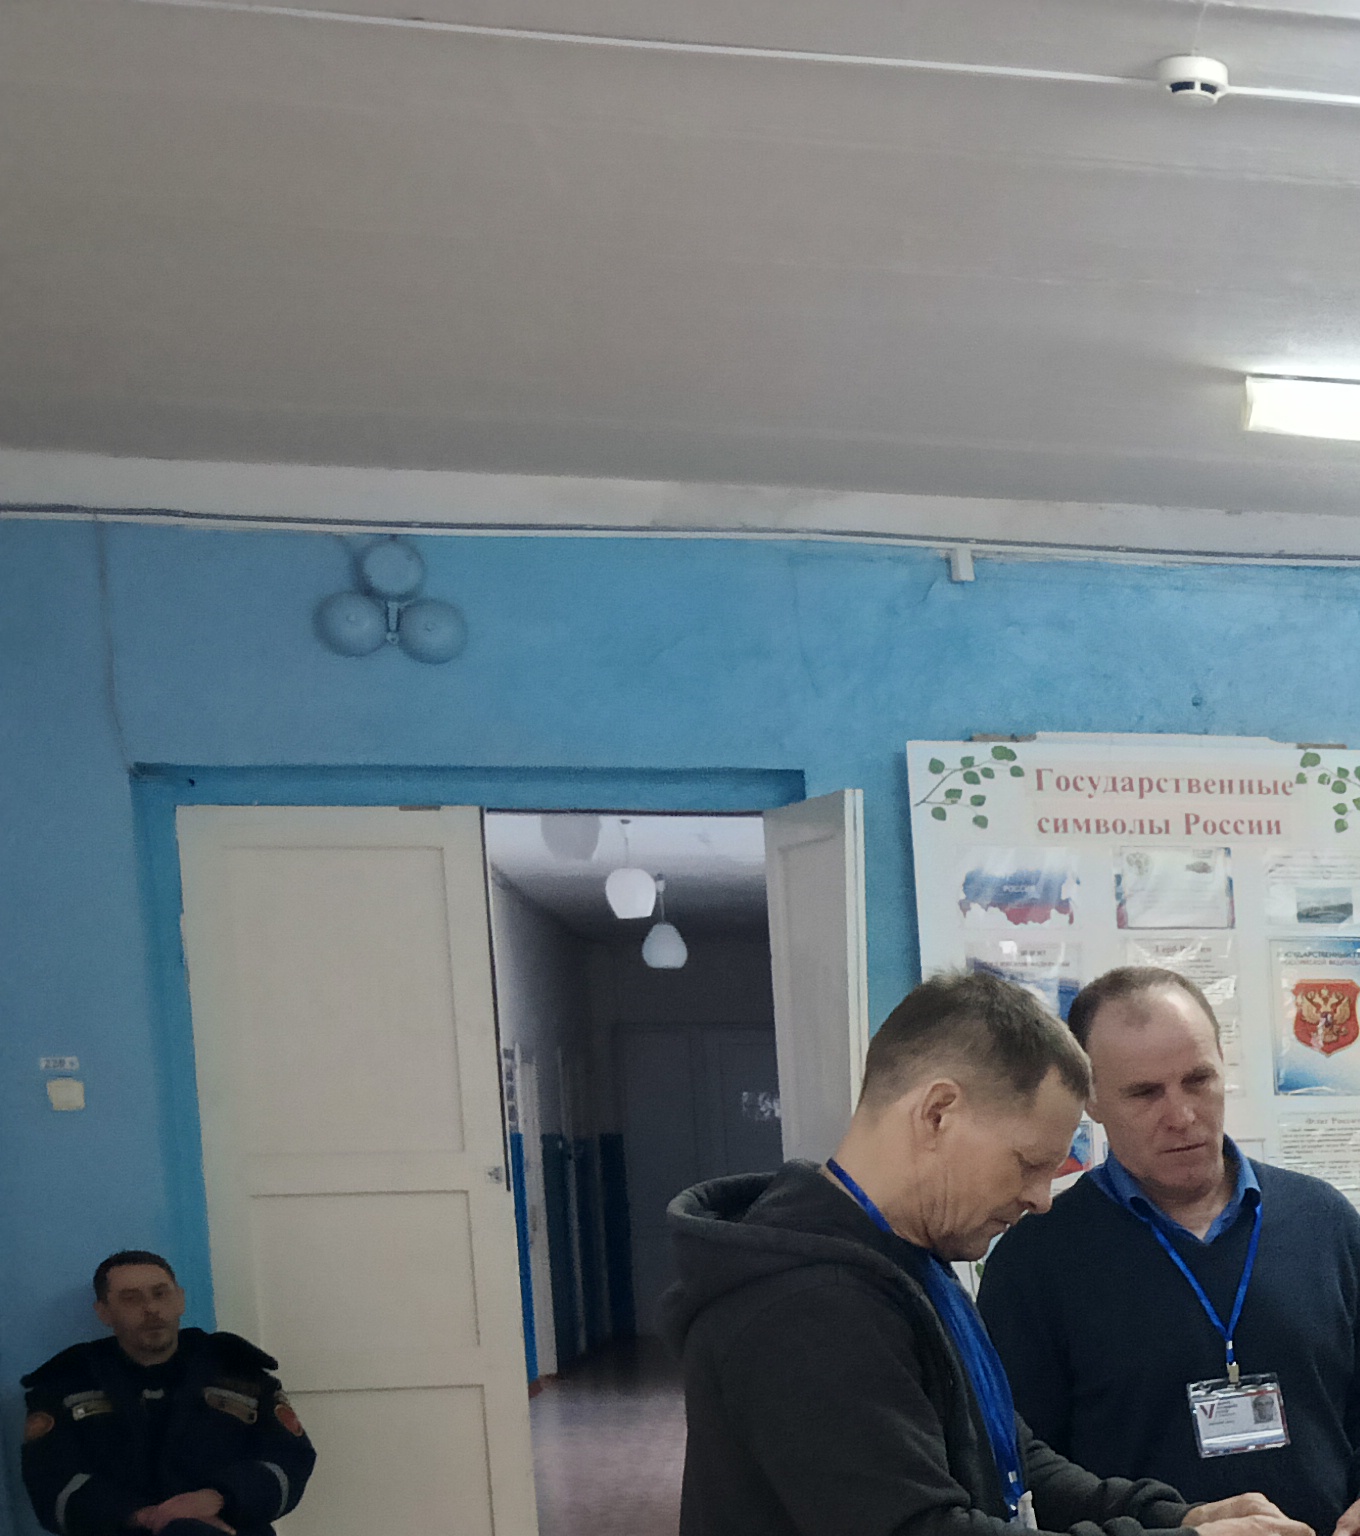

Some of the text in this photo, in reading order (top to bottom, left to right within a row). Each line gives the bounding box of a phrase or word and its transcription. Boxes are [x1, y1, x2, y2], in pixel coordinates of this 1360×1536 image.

[1035, 768, 1294, 799] Государственные
[1037, 812, 1282, 836] символы России
